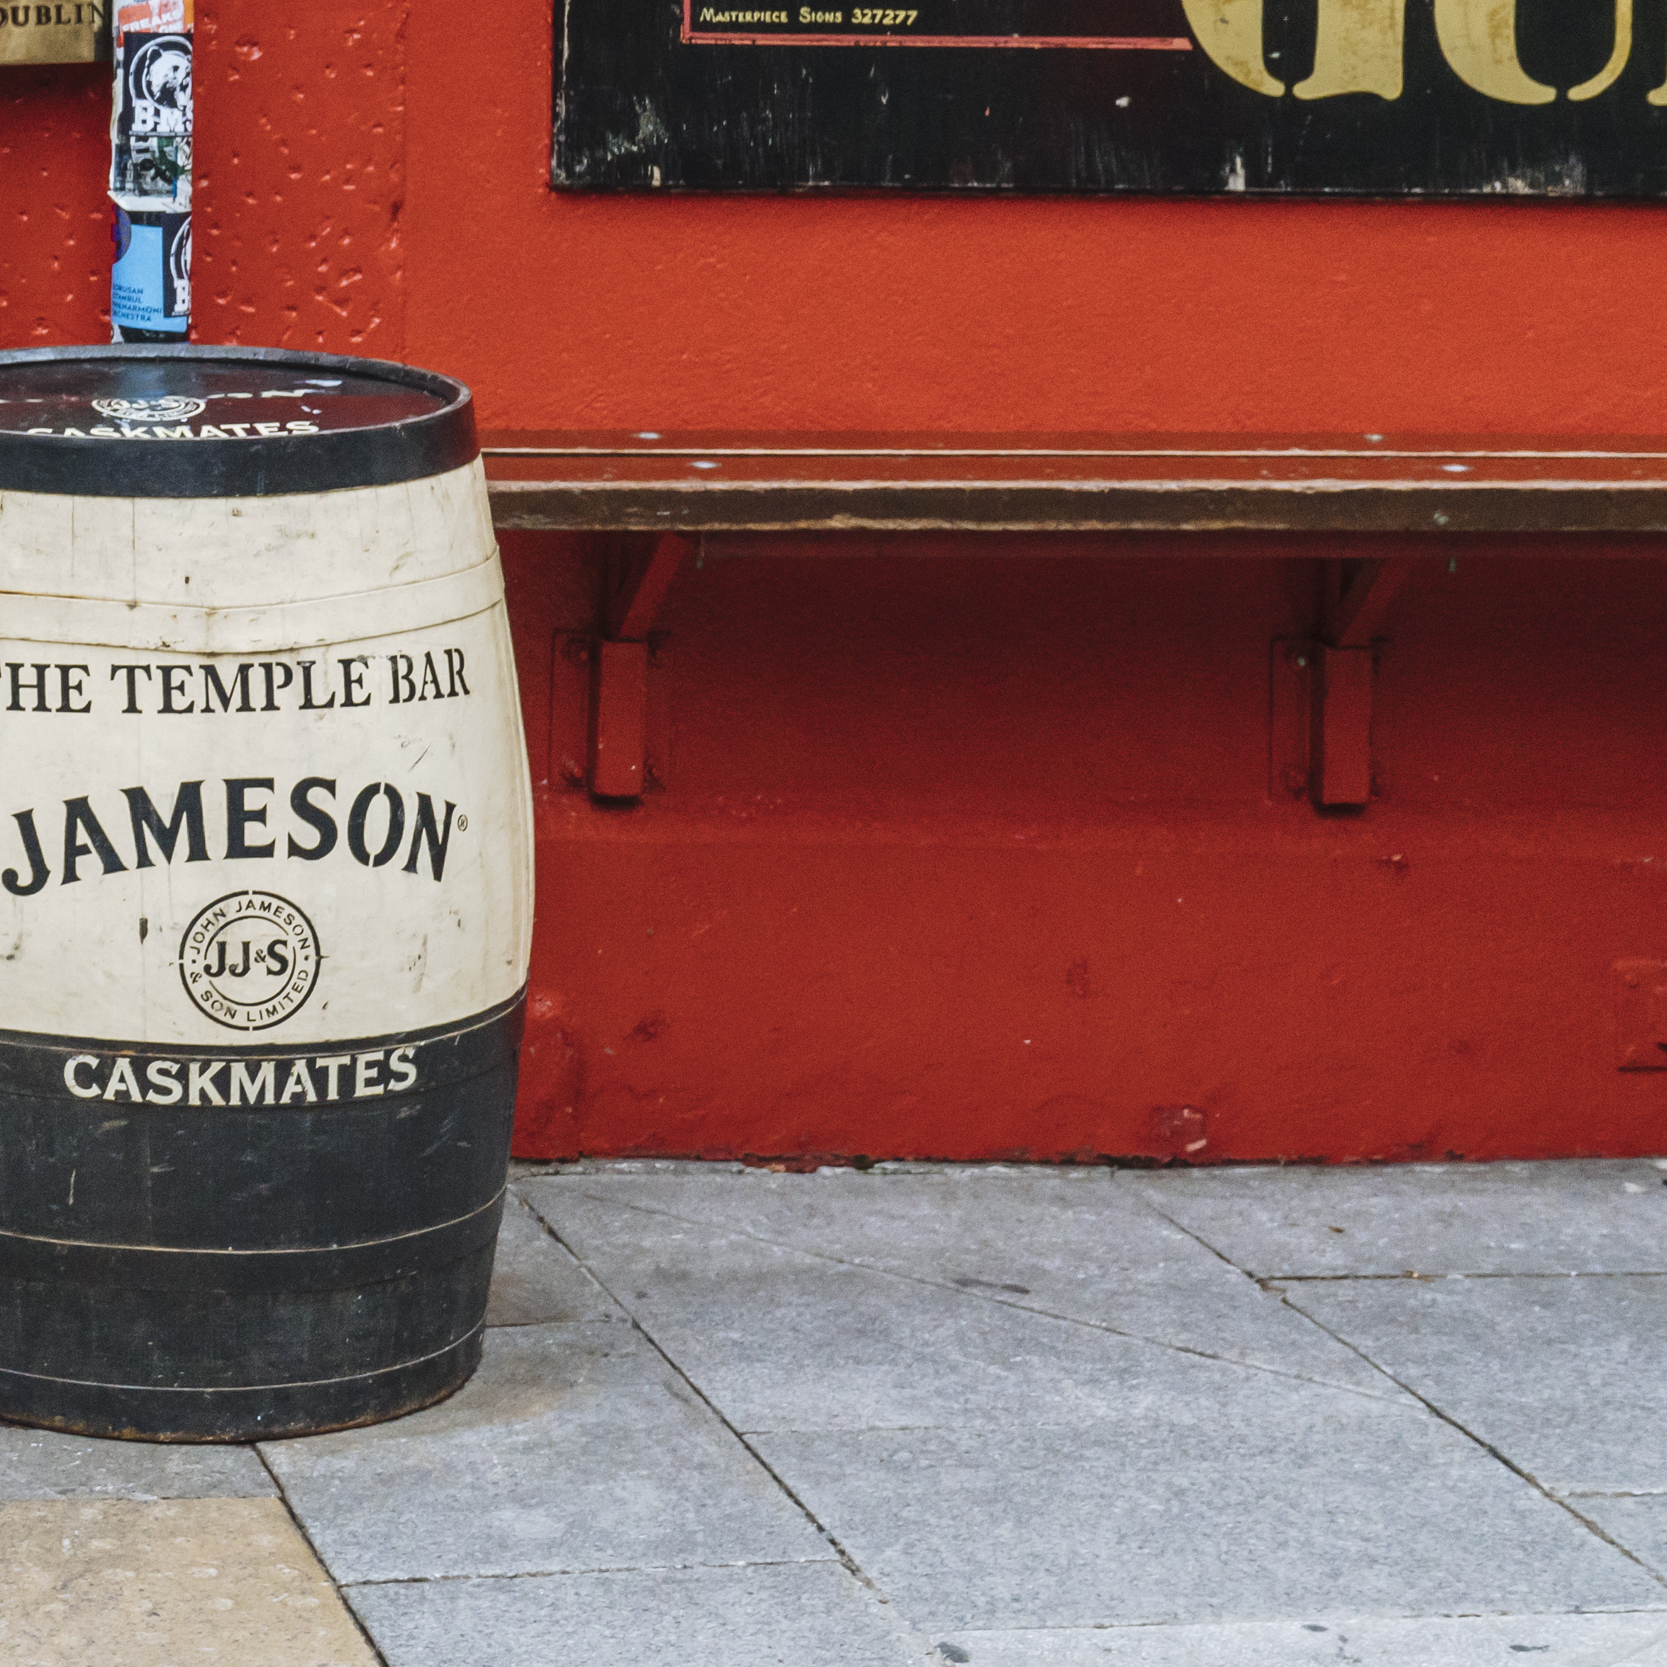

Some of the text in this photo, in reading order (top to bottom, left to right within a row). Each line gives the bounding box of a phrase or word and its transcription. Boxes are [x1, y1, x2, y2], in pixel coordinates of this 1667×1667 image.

[851, 8, 918, 26] 327277
[110, 655, 372, 715] TEMPLE
[388, 647, 471, 705] BAR
[189, 899, 311, 955] JOHN JAMESON
[203, 938, 289, 978] JJ&S
[201, 990, 237, 1020] SON
[247, 970, 309, 1022] LIMITED
[63, 1047, 418, 1106] CASKMATES
